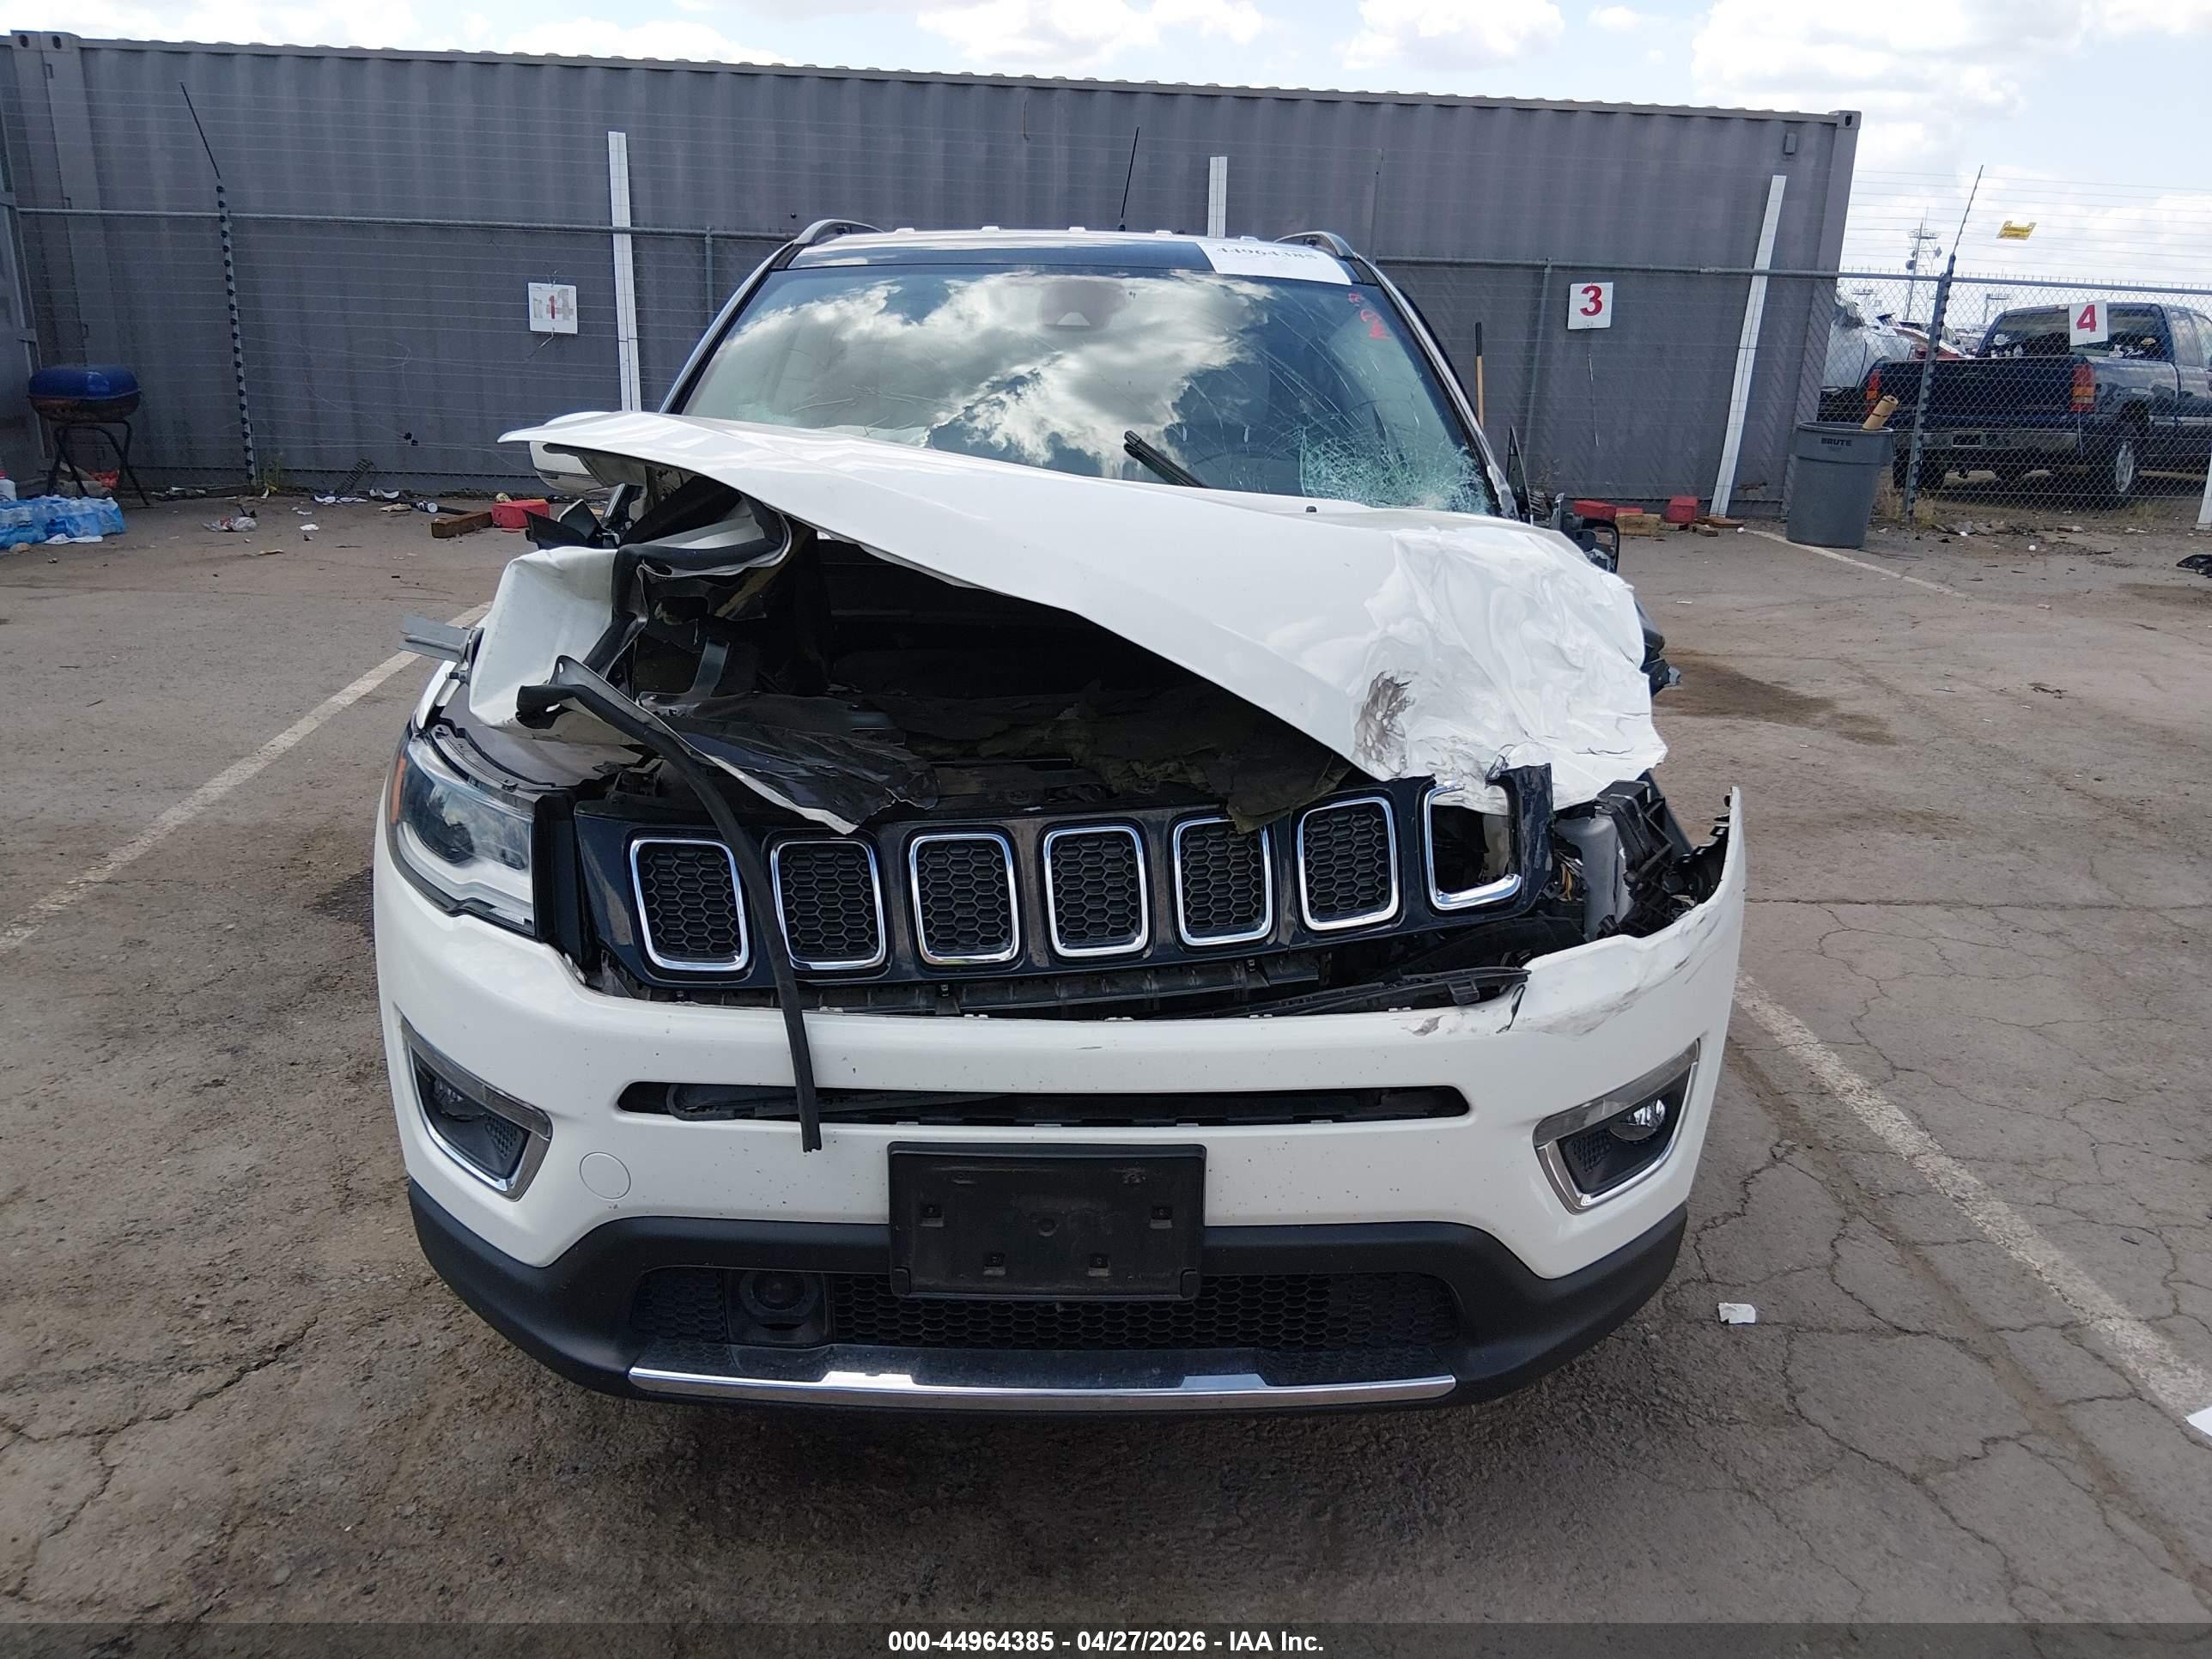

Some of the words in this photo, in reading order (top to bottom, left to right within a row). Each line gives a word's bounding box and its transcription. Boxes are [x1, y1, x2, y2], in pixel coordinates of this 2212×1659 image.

[1579, 285, 1603, 317] 3
[2075, 304, 2097, 333] 4
[1820, 437, 1853, 447] BRUTE
